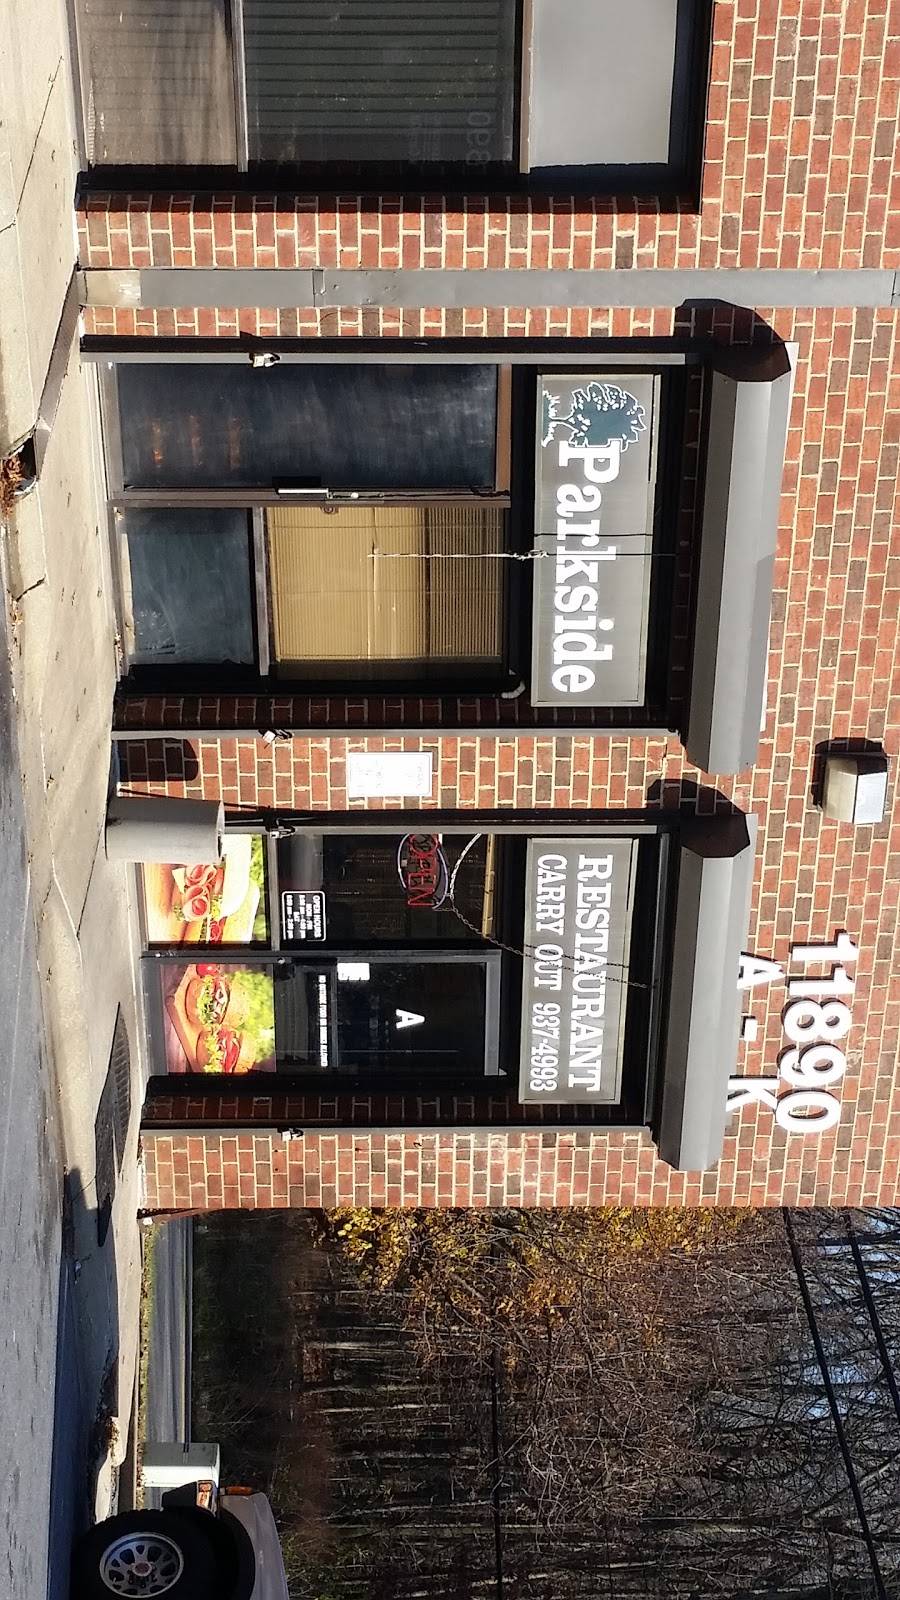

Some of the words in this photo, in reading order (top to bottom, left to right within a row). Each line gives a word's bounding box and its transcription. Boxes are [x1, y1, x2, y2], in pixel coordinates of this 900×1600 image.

[551, 438, 622, 693] Parkside
[407, 834, 439, 907] OPEN
[535, 854, 568, 936] CARRY
[533, 943, 564, 991] OUT
[568, 854, 614, 1092] RESTAURANT
[736, 954, 786, 990] A
[395, 1009, 425, 1029] A
[529, 1002, 561, 1092] 937-4993
[775, 932, 860, 1134] 11890
[725, 1078, 781, 1113] K
